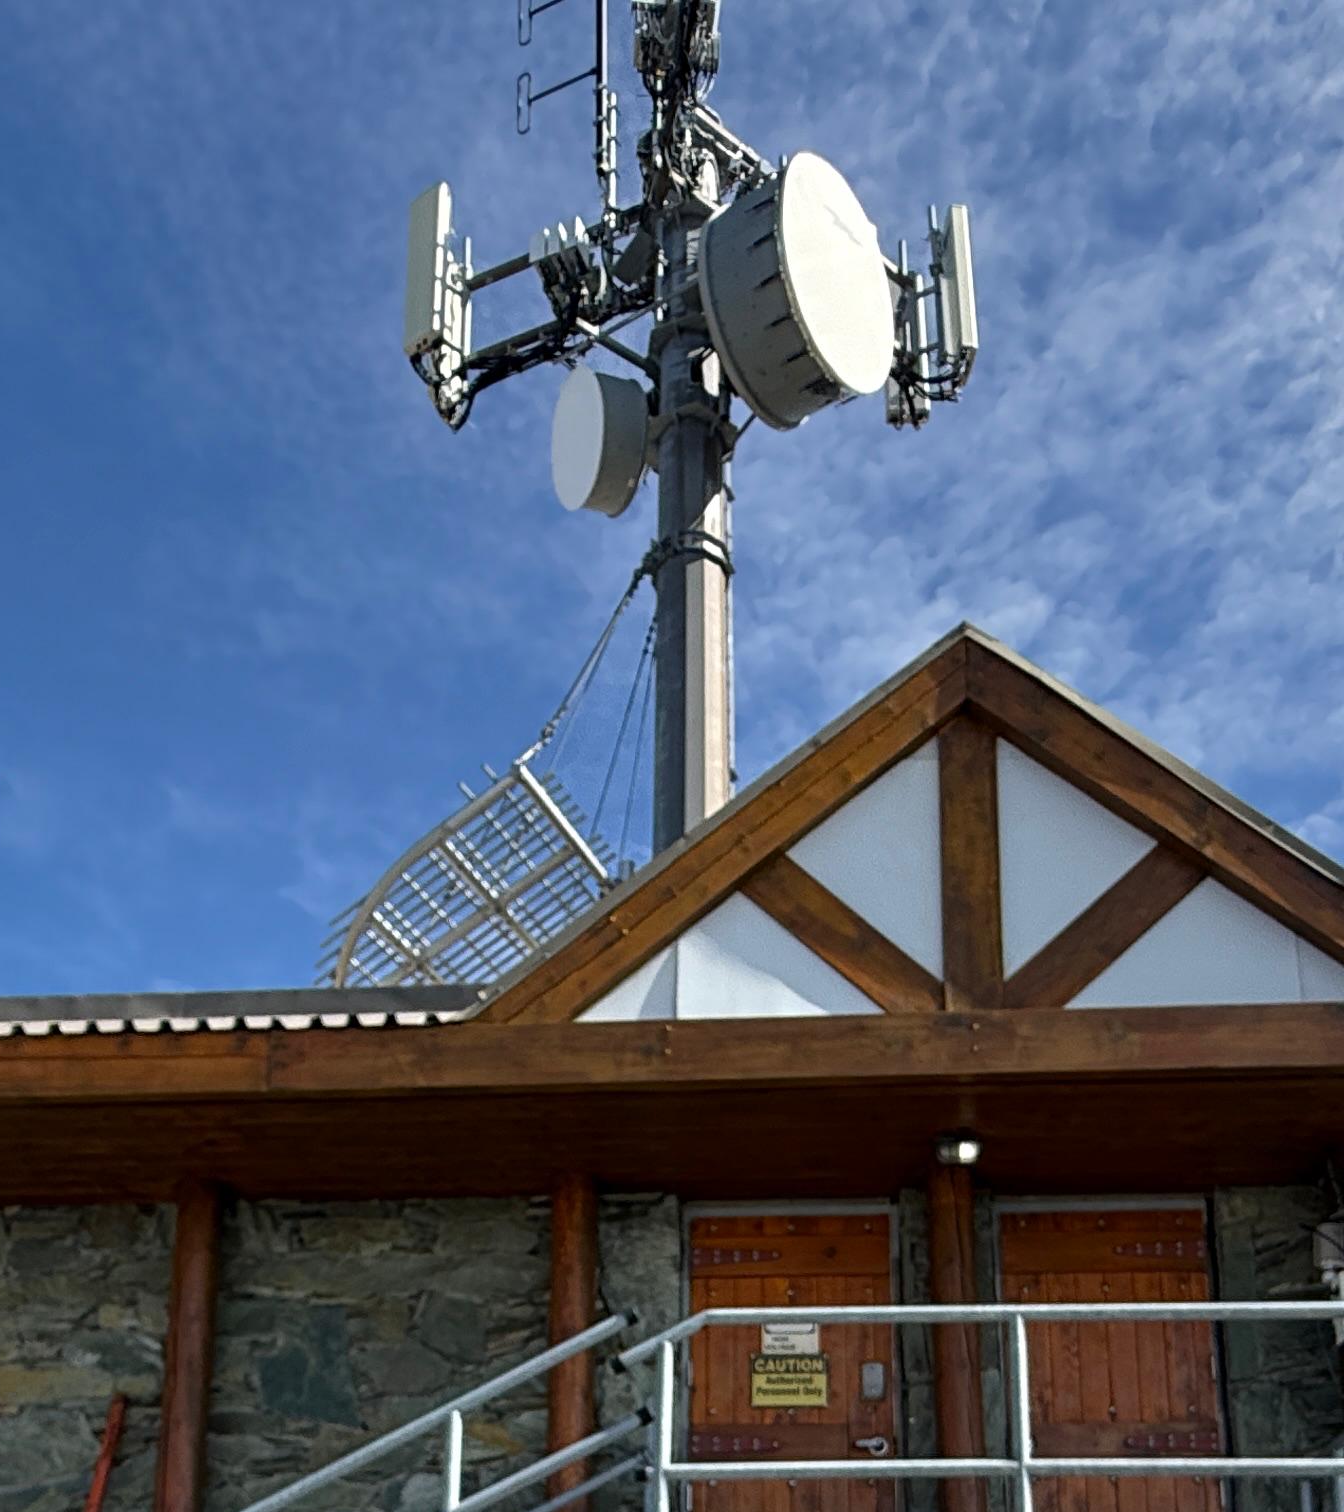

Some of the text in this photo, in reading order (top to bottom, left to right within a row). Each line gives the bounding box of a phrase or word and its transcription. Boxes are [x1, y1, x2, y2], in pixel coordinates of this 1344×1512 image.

[754, 1358, 823, 1372] CAUTION
[756, 1386, 823, 1397] Personnel Only
